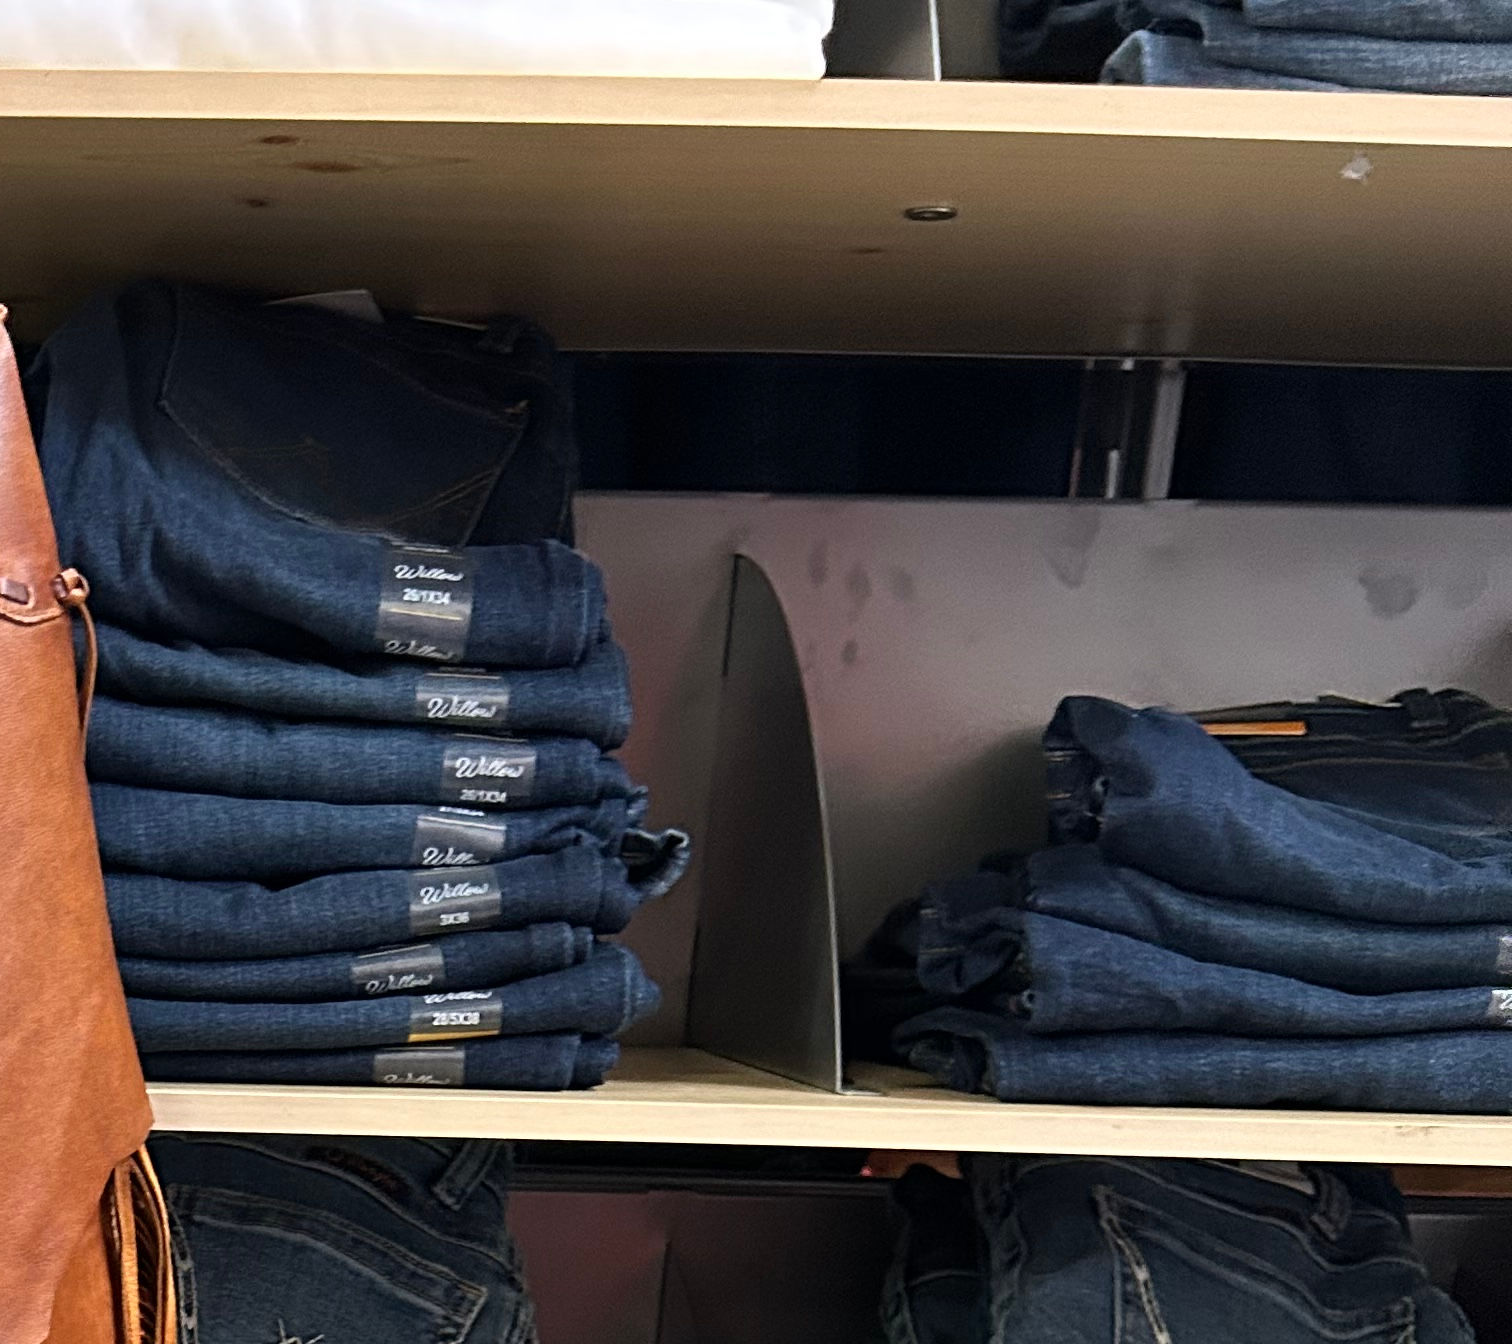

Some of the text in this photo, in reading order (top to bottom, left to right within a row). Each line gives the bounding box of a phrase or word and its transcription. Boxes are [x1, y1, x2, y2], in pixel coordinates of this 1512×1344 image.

[394, 564, 464, 582] Willow
[428, 695, 497, 718] Willow
[455, 755, 524, 778] Willow
[420, 883, 489, 905] Willow
